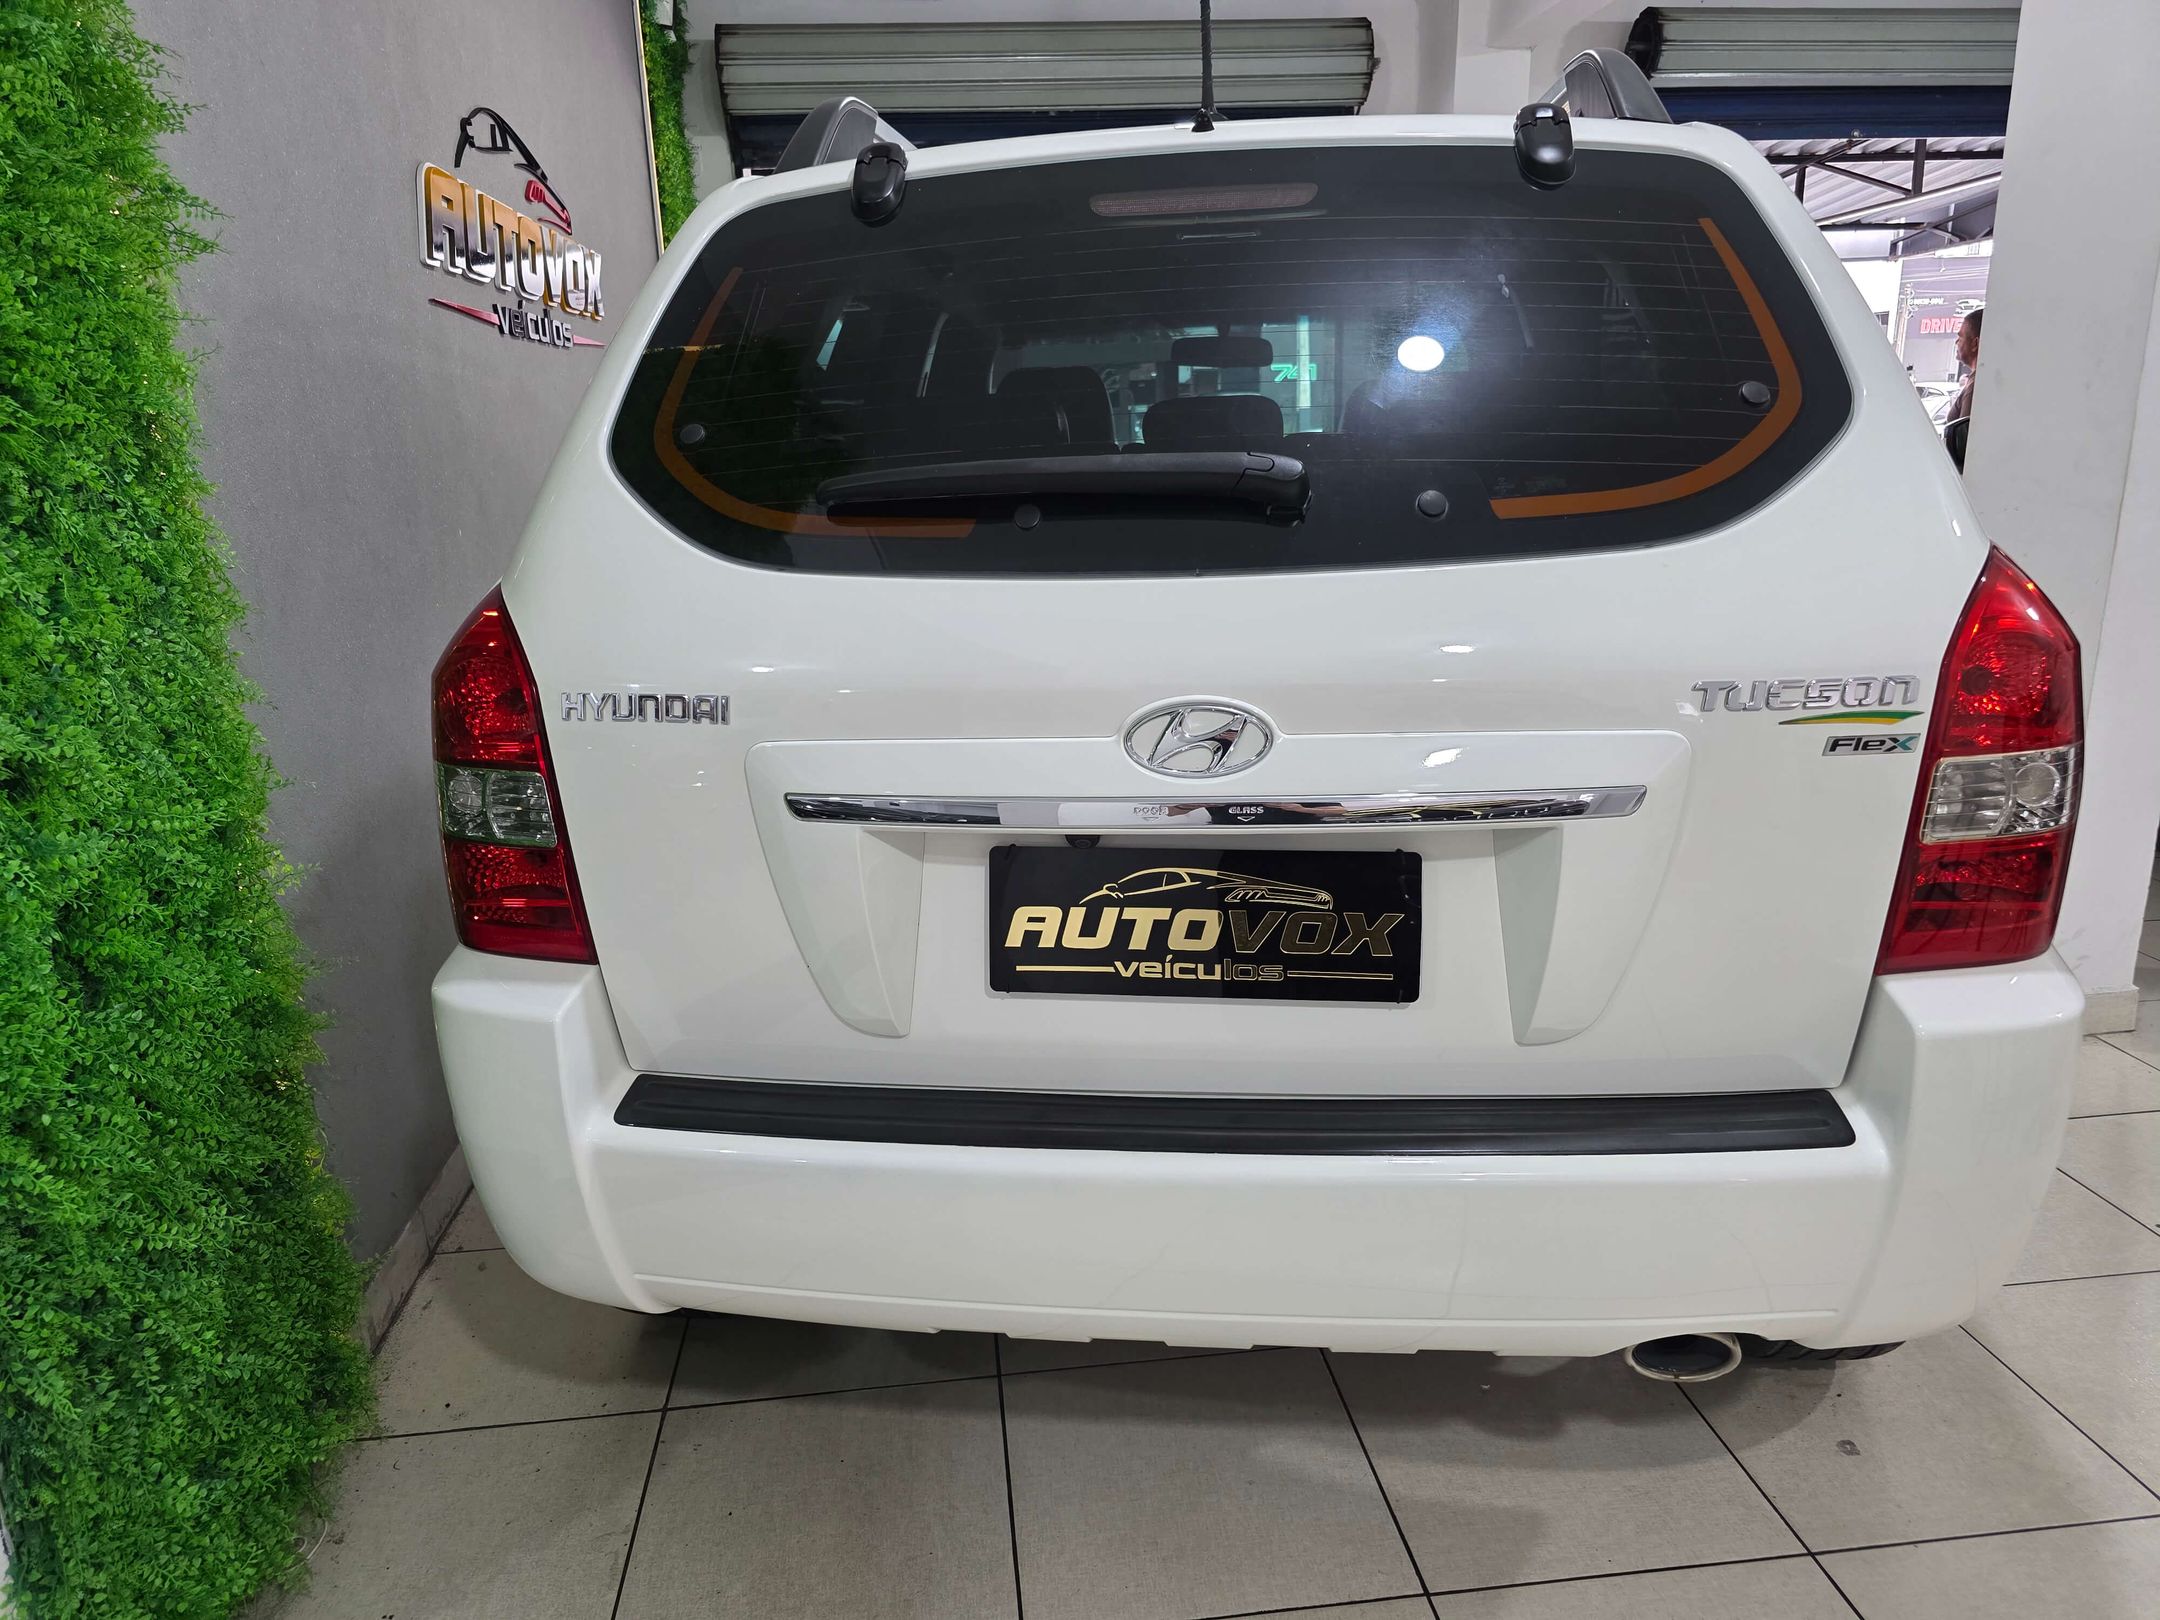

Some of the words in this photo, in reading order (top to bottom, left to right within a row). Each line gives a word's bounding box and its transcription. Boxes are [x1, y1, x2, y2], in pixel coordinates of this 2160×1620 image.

[416, 162, 605, 321] AUTOVOX
[492, 299, 574, 348] veículos
[1920, 316, 1964, 334] DRIVE
[560, 692, 731, 726] HYUNDAI
[1691, 674, 1921, 713] TUCSON
[1228, 805, 1265, 815] GLASS
[1004, 905, 1405, 958] AUTOVOX
[1113, 954, 1285, 982] veículos
